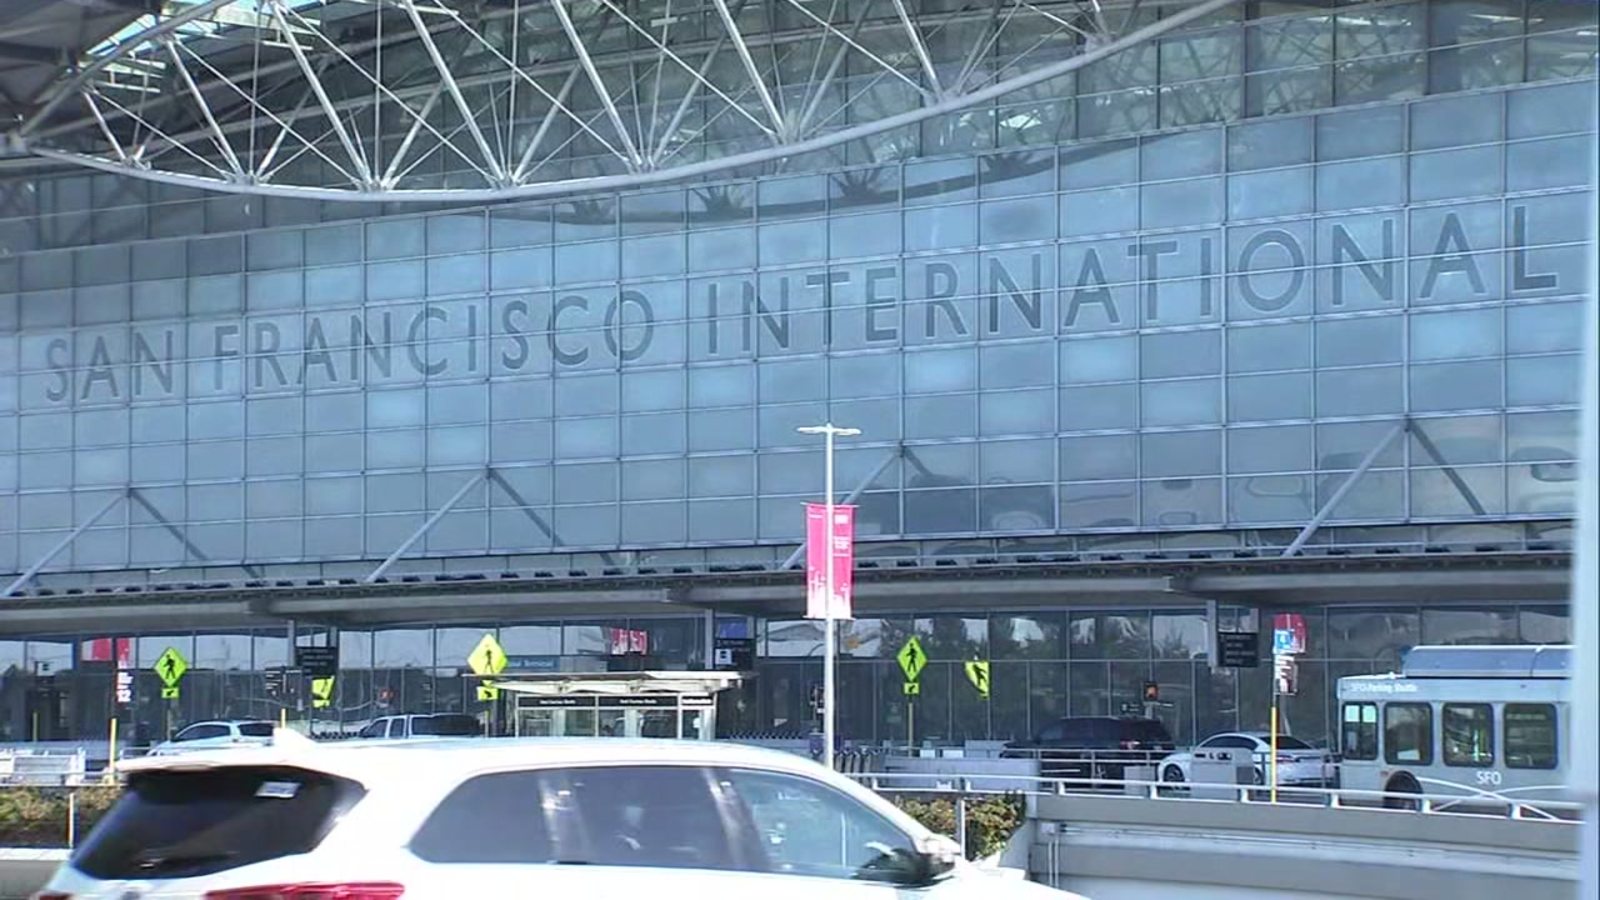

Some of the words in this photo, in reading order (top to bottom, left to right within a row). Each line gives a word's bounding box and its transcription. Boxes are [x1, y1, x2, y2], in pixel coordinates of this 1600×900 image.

[46, 330, 174, 402] SAN
[214, 289, 654, 391] FRANCISCO
[708, 205, 1558, 355] INTERNATIONAL
[1475, 771, 1502, 785] SFO
